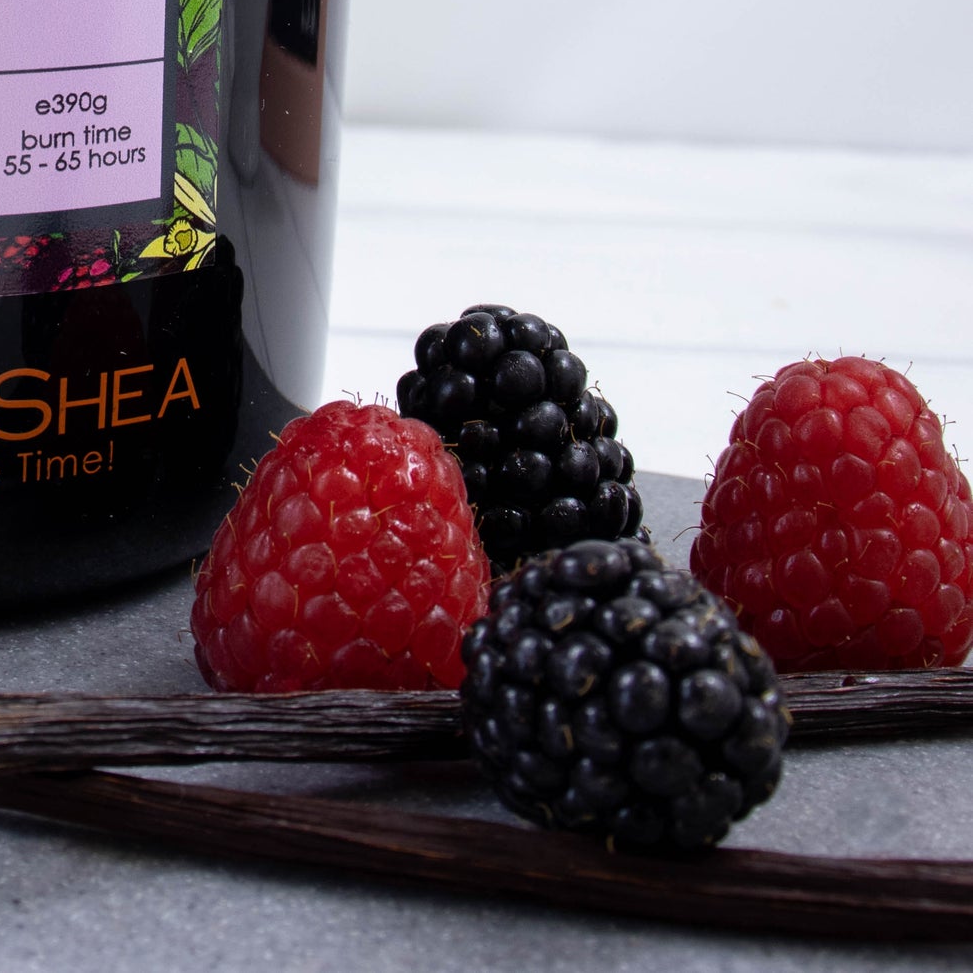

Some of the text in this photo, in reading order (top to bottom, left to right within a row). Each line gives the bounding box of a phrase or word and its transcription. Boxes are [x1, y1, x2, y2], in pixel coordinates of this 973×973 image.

[34, 91, 108, 116] e390g
[21, 124, 132, 151] burn time
[3, 154, 32, 176] 55
[55, 150, 81, 172] 65
[88, 146, 146, 169] hours
[16, 439, 114, 483] Time!
